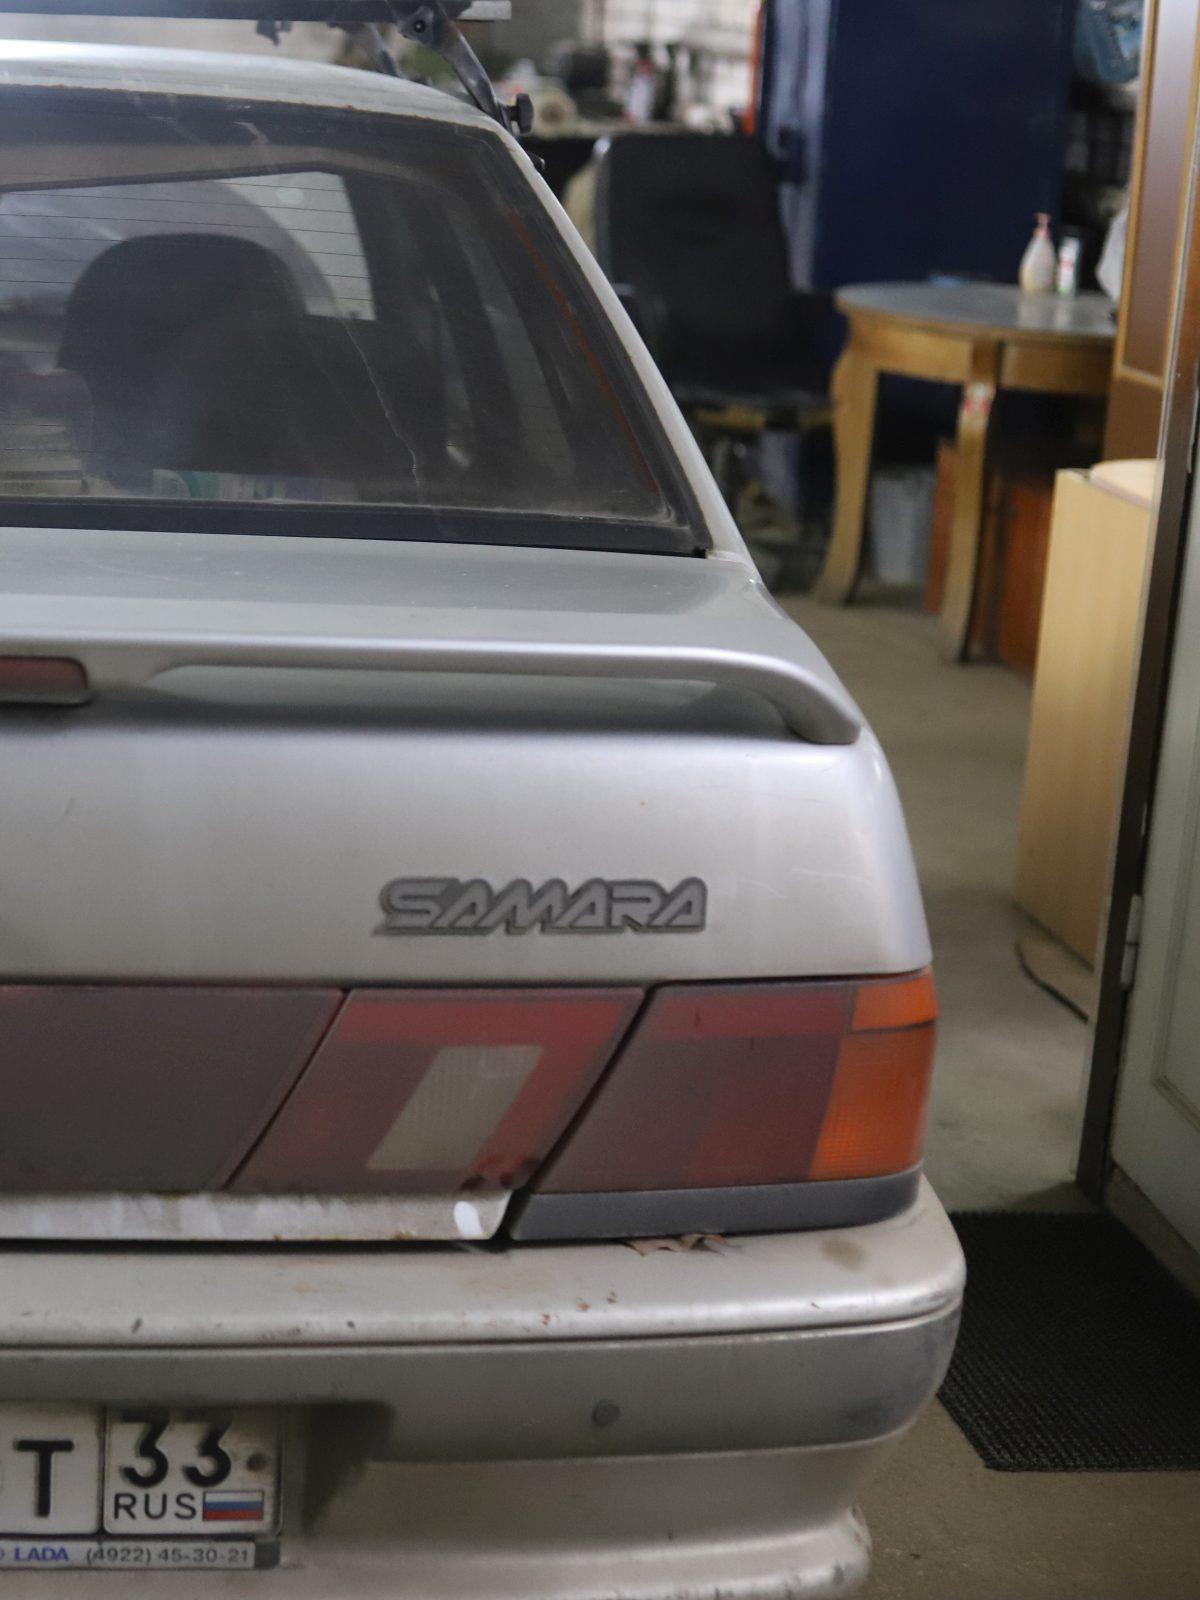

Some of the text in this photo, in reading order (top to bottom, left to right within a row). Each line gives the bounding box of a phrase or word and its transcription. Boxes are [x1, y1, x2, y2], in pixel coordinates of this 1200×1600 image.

[375, 876, 708, 936] SAMARA
[121, 1408, 233, 1488] 33
[113, 1492, 198, 1520] RUS
[13, 1547, 71, 1563] LADA
[86, 1547, 250, 1565] (4922) 45-30-21
